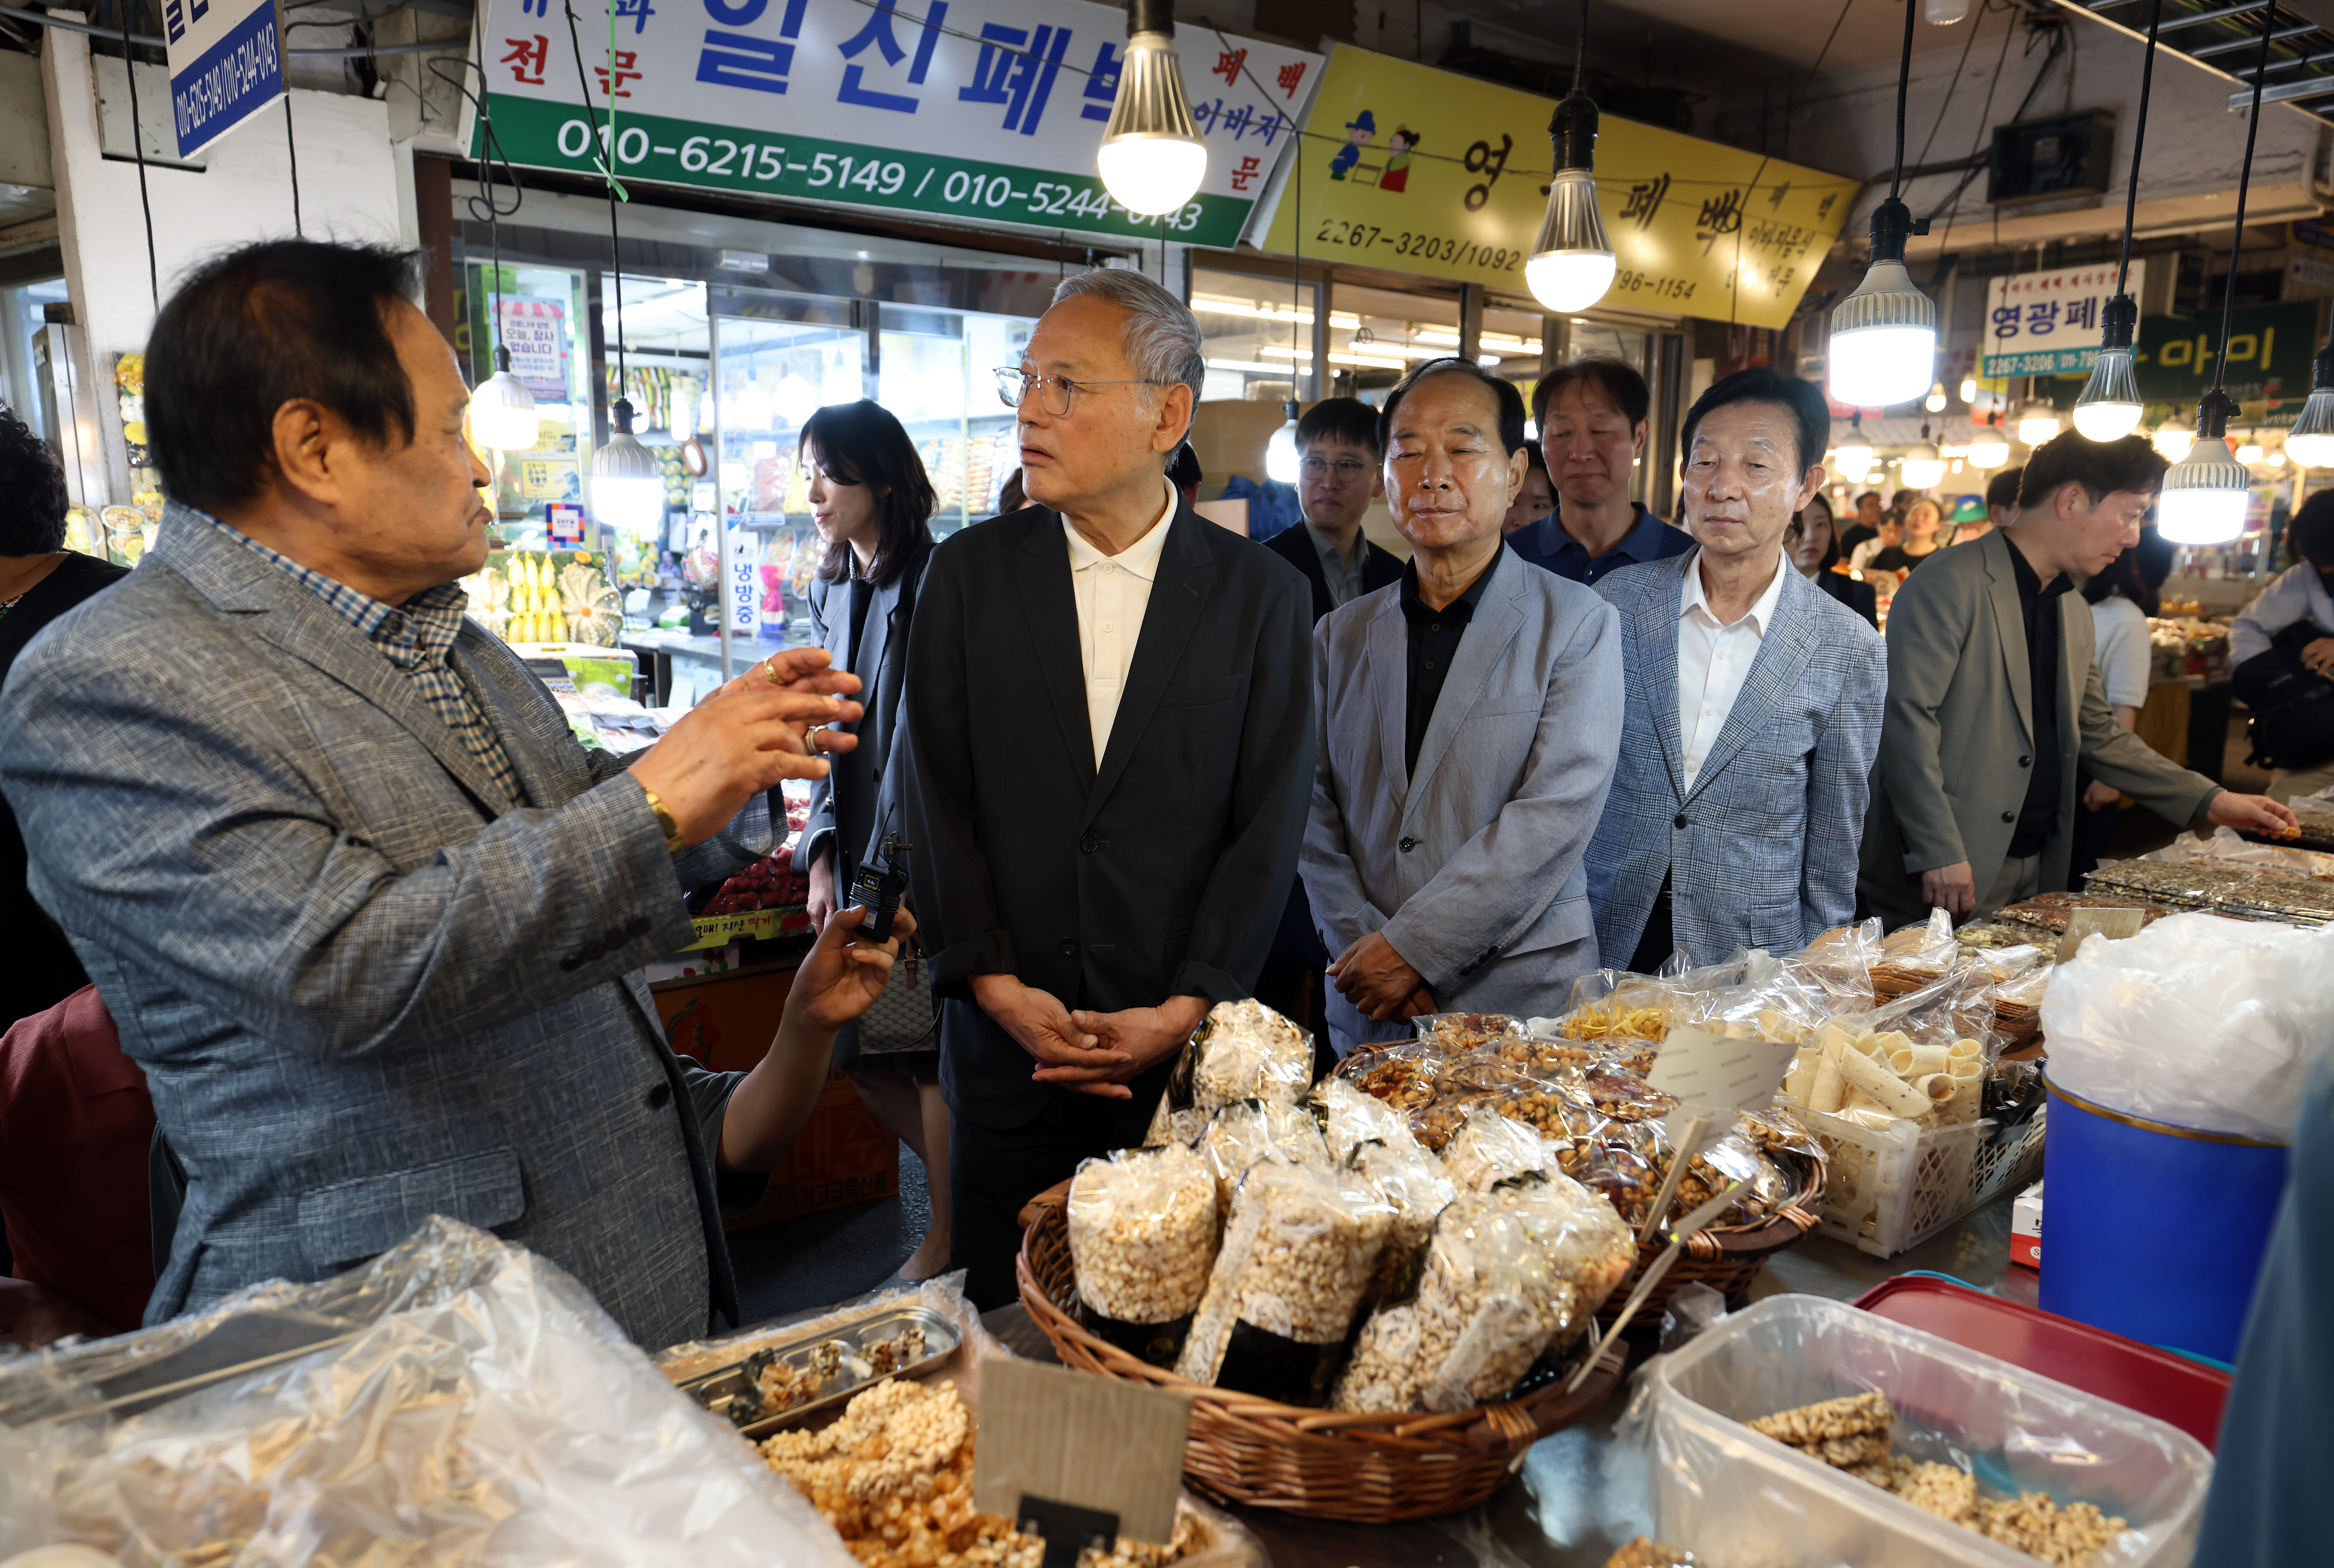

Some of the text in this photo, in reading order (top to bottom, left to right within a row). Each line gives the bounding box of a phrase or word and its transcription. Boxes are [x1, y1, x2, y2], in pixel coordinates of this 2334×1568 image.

[557, 118, 906, 195] 010-6215-5149
[509, 341, 552, 354] 없습니다
[2137, 326, 2275, 376] 마미
[733, 562, 754, 624] 냉방중
